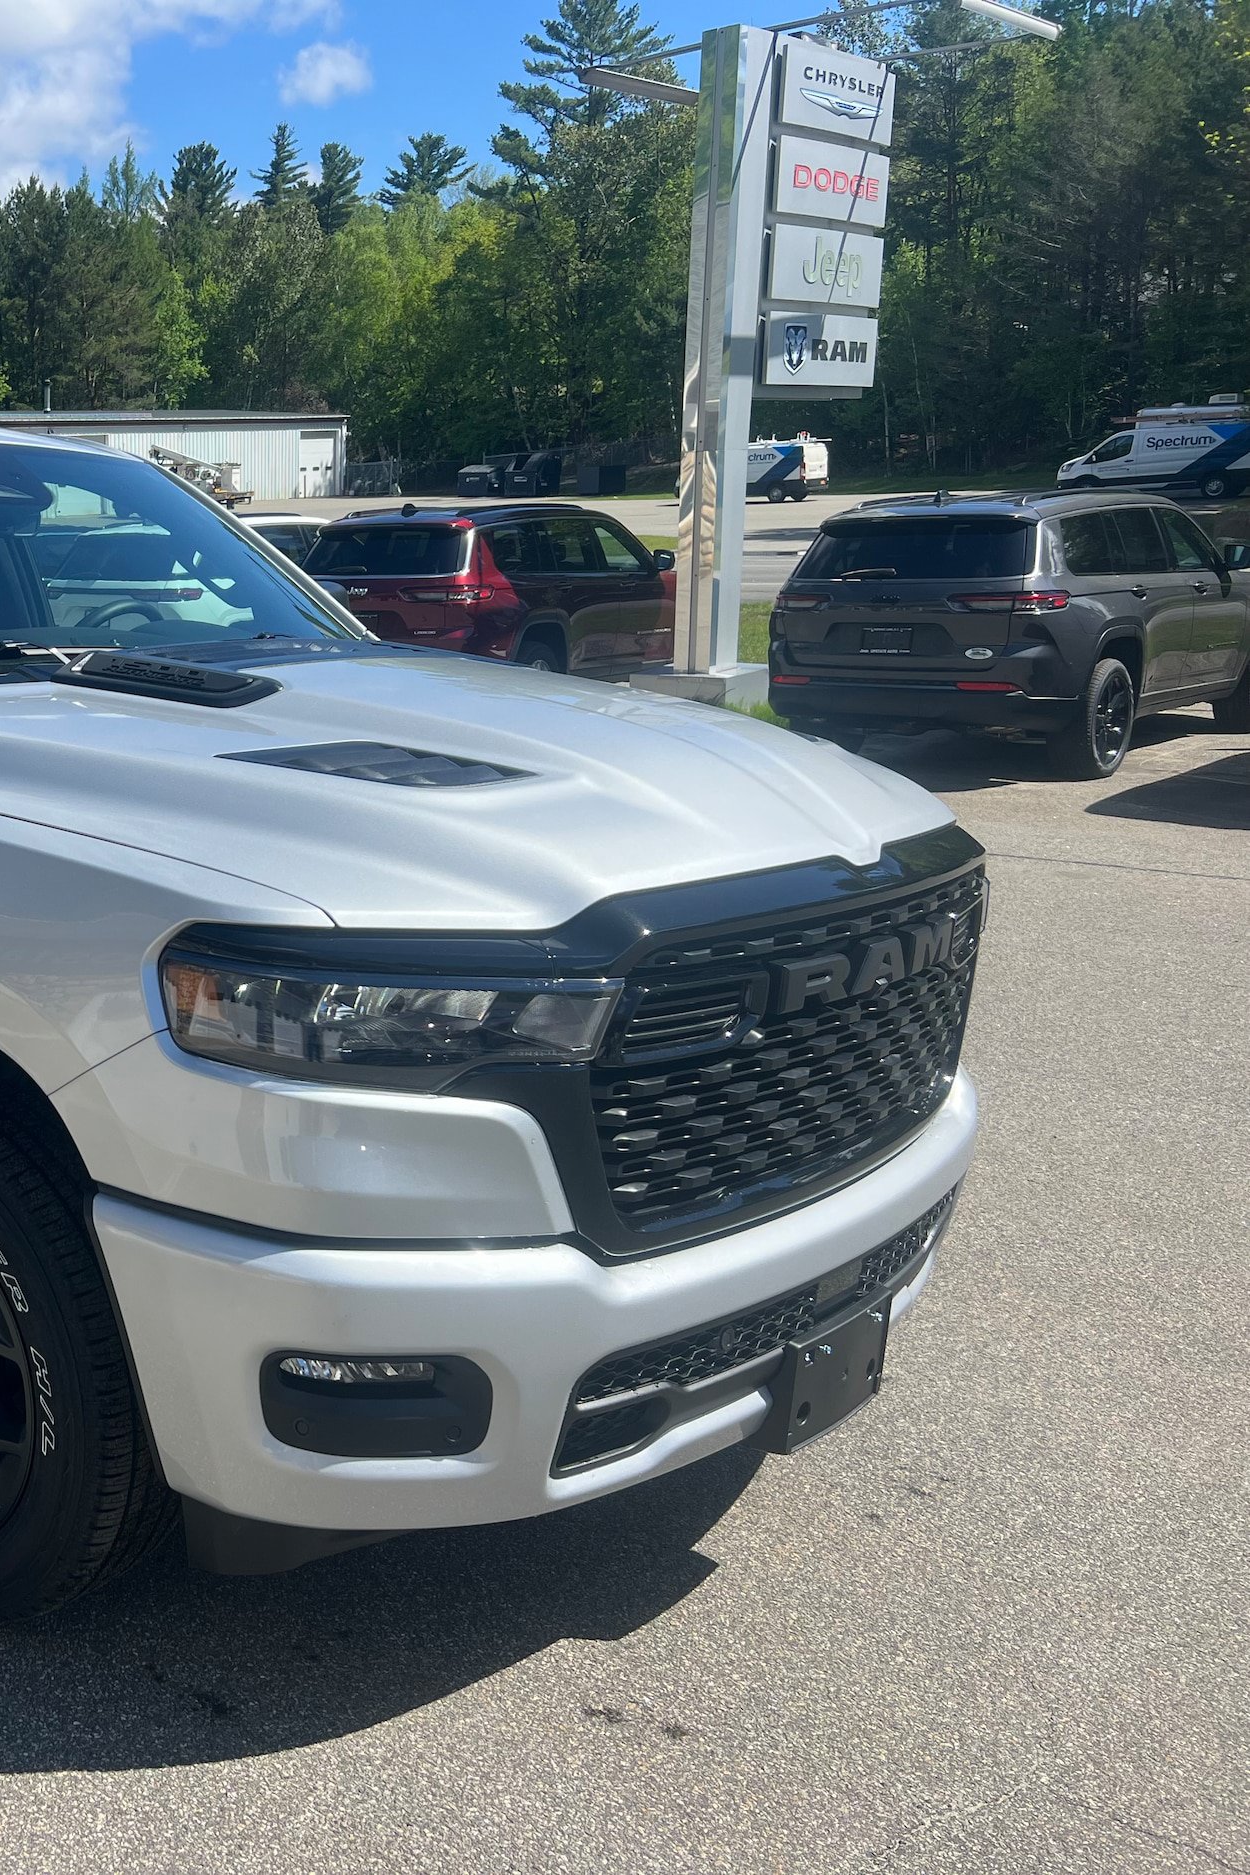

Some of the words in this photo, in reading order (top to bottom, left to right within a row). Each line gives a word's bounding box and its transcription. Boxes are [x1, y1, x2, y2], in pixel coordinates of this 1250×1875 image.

[803, 66, 883, 99] CHRYSLER
[793, 163, 879, 202] DODGE
[803, 236, 863, 297] Jeep
[811, 338, 868, 364] RAM
[748, 453, 774, 462] ctrum
[1146, 435, 1215, 451] Spectrum
[347, 586, 368, 596] Jeep
[770, 912, 954, 1015] RAM
